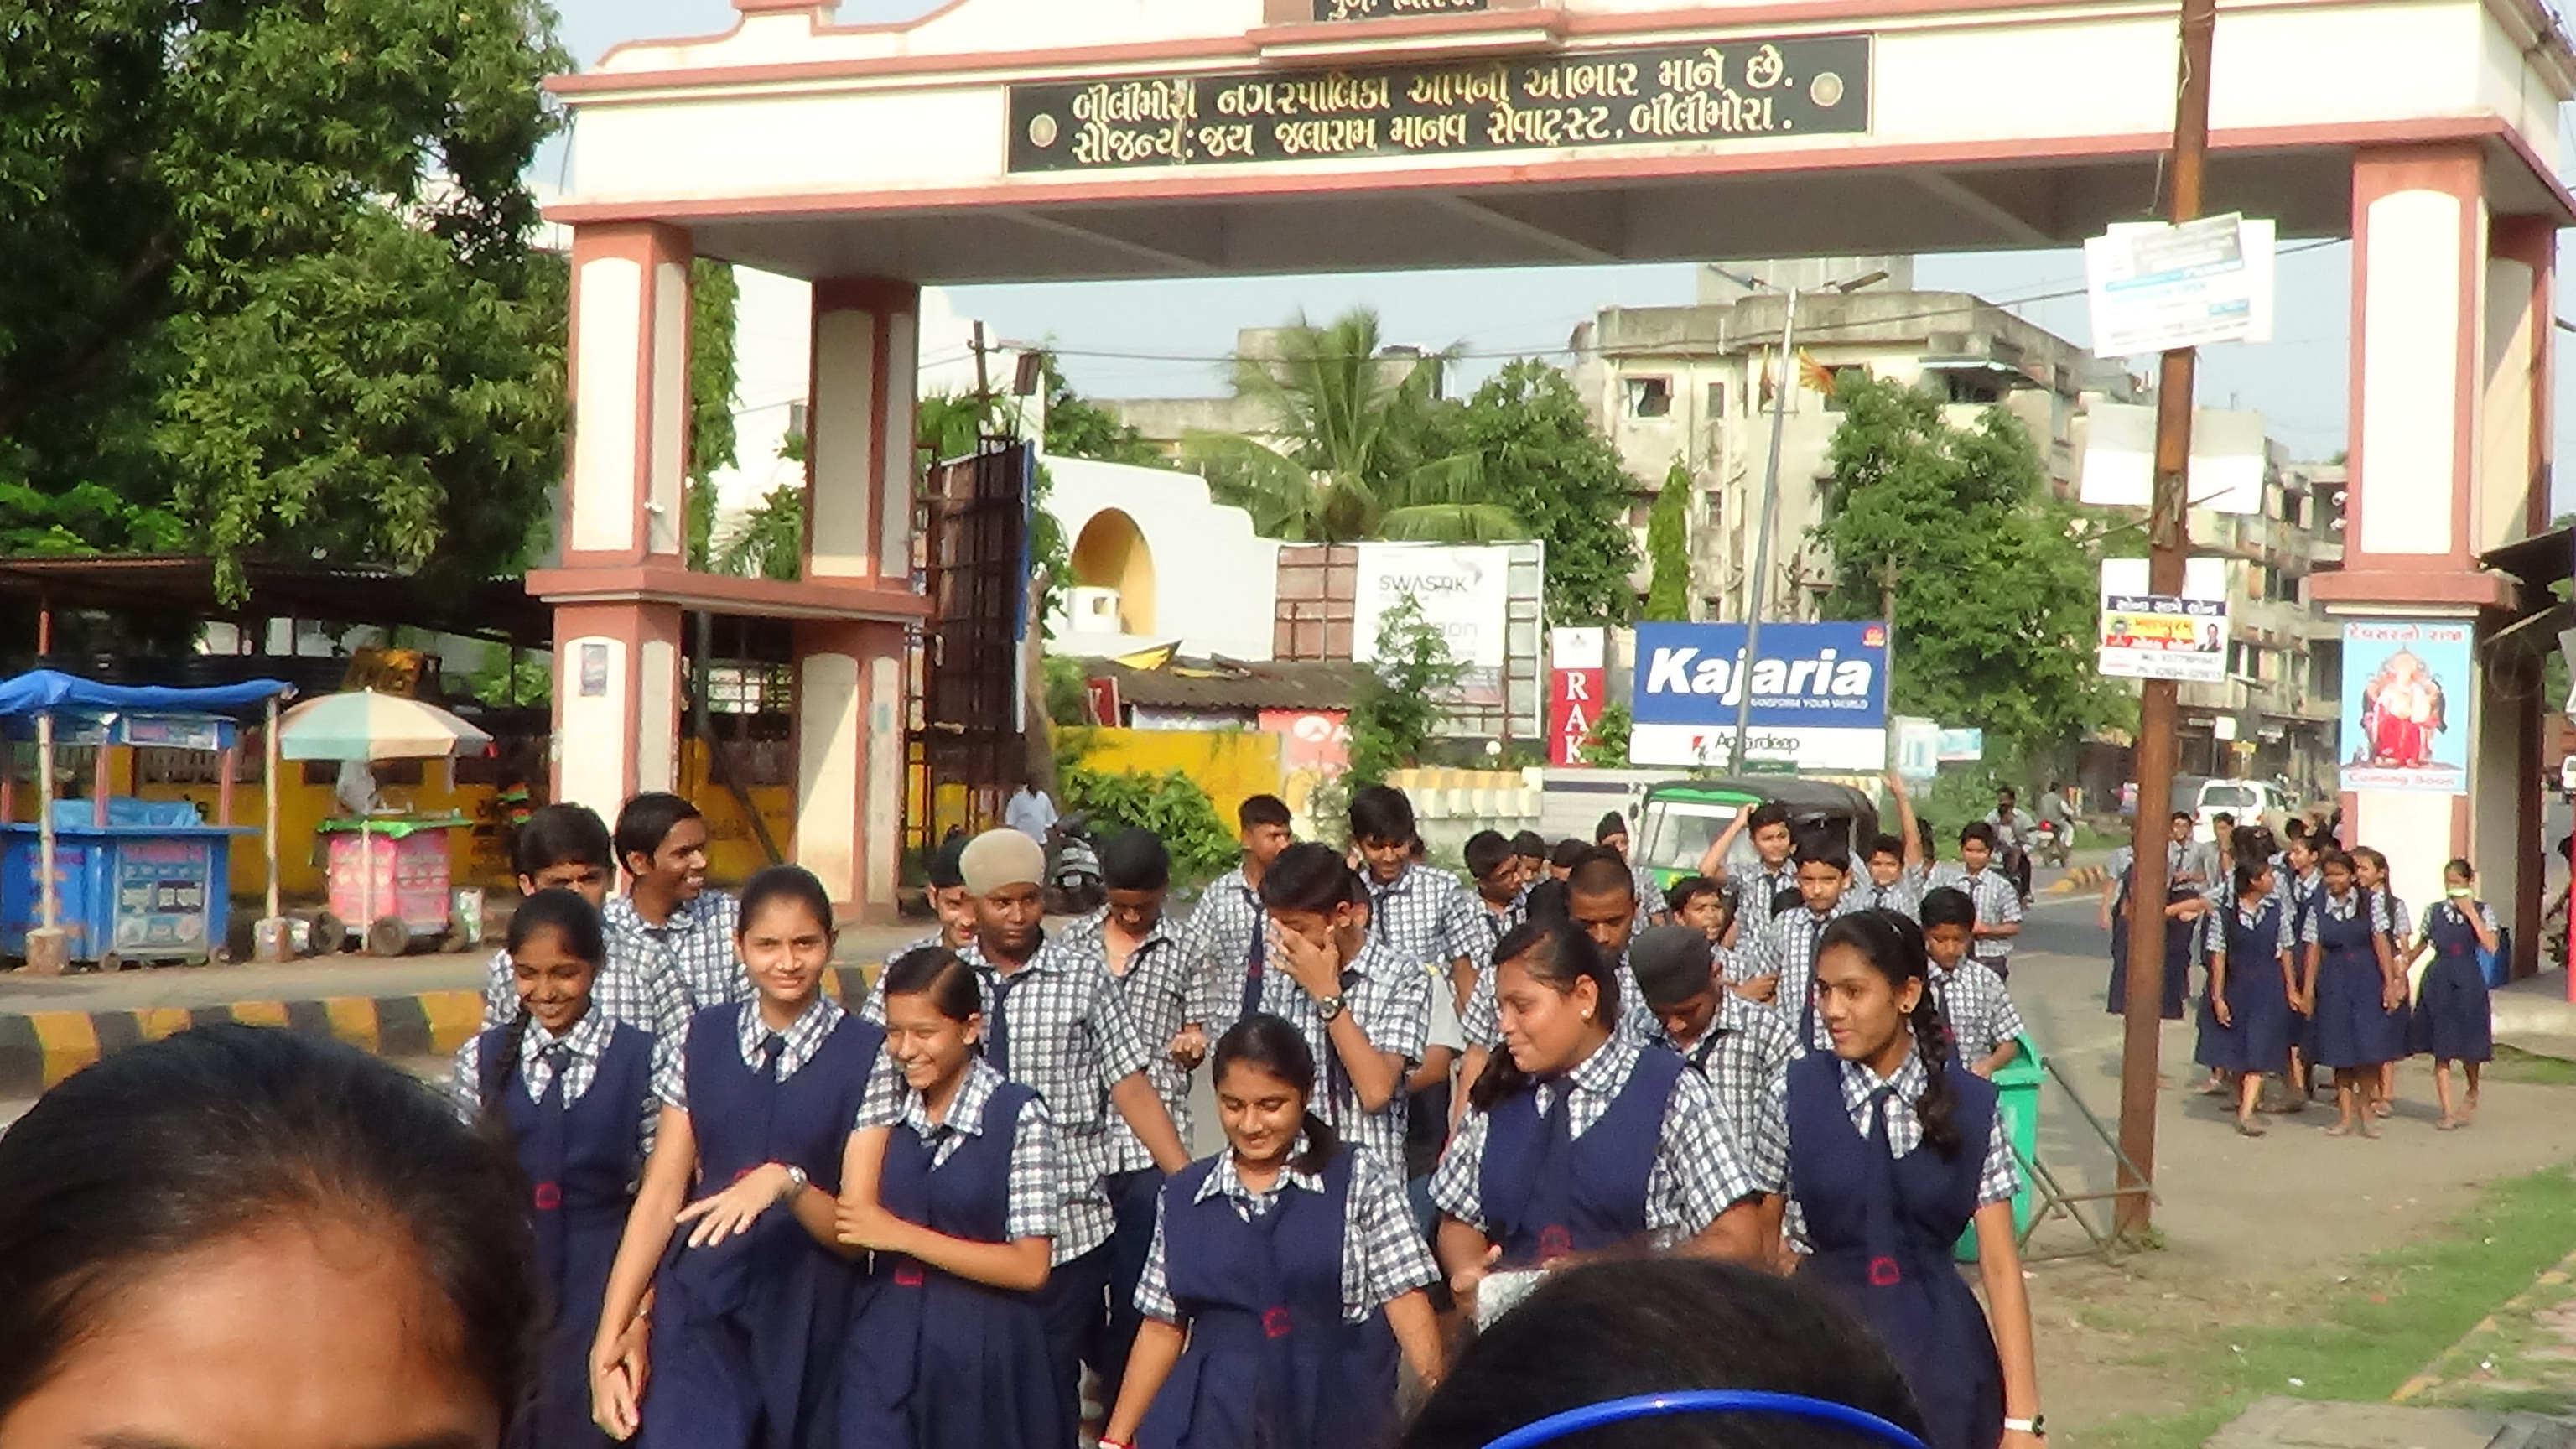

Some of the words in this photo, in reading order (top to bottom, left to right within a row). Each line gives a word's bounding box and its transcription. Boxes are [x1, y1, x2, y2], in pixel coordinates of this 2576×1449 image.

[1218, 72, 1391, 117] નગરપાલિકા
[1523, 61, 1639, 100] આભાર
[1659, 47, 1725, 93] માને
[1746, 44, 1794, 91] છે.
[1275, 117, 1378, 154] જલારામ
[1390, 112, 1467, 148] માનવ
[1379, 574, 1468, 593] SWASTIK
[1647, 647, 1872, 706] Kajaria
